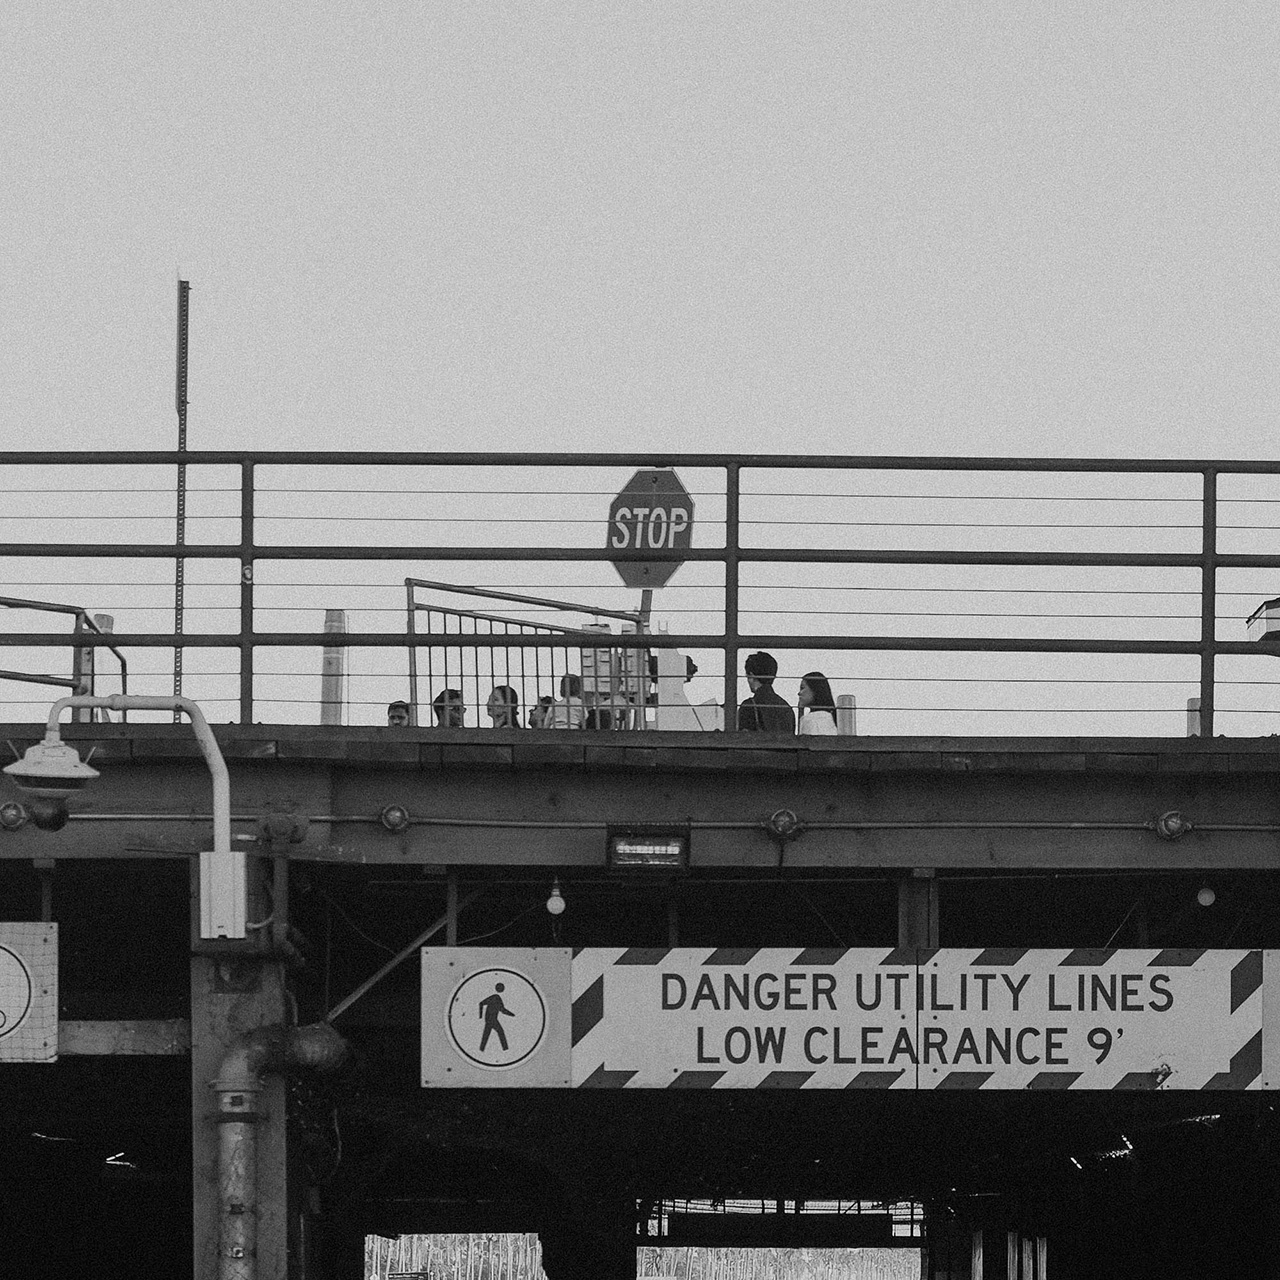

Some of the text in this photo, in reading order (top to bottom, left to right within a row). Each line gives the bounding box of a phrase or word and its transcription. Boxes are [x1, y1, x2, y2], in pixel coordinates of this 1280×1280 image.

[611, 507, 688, 549] STOP
[661, 973, 1174, 1012] DANGER UTILITY LINES
[697, 1026, 1124, 1065] LOW CLEARANCE 9'
